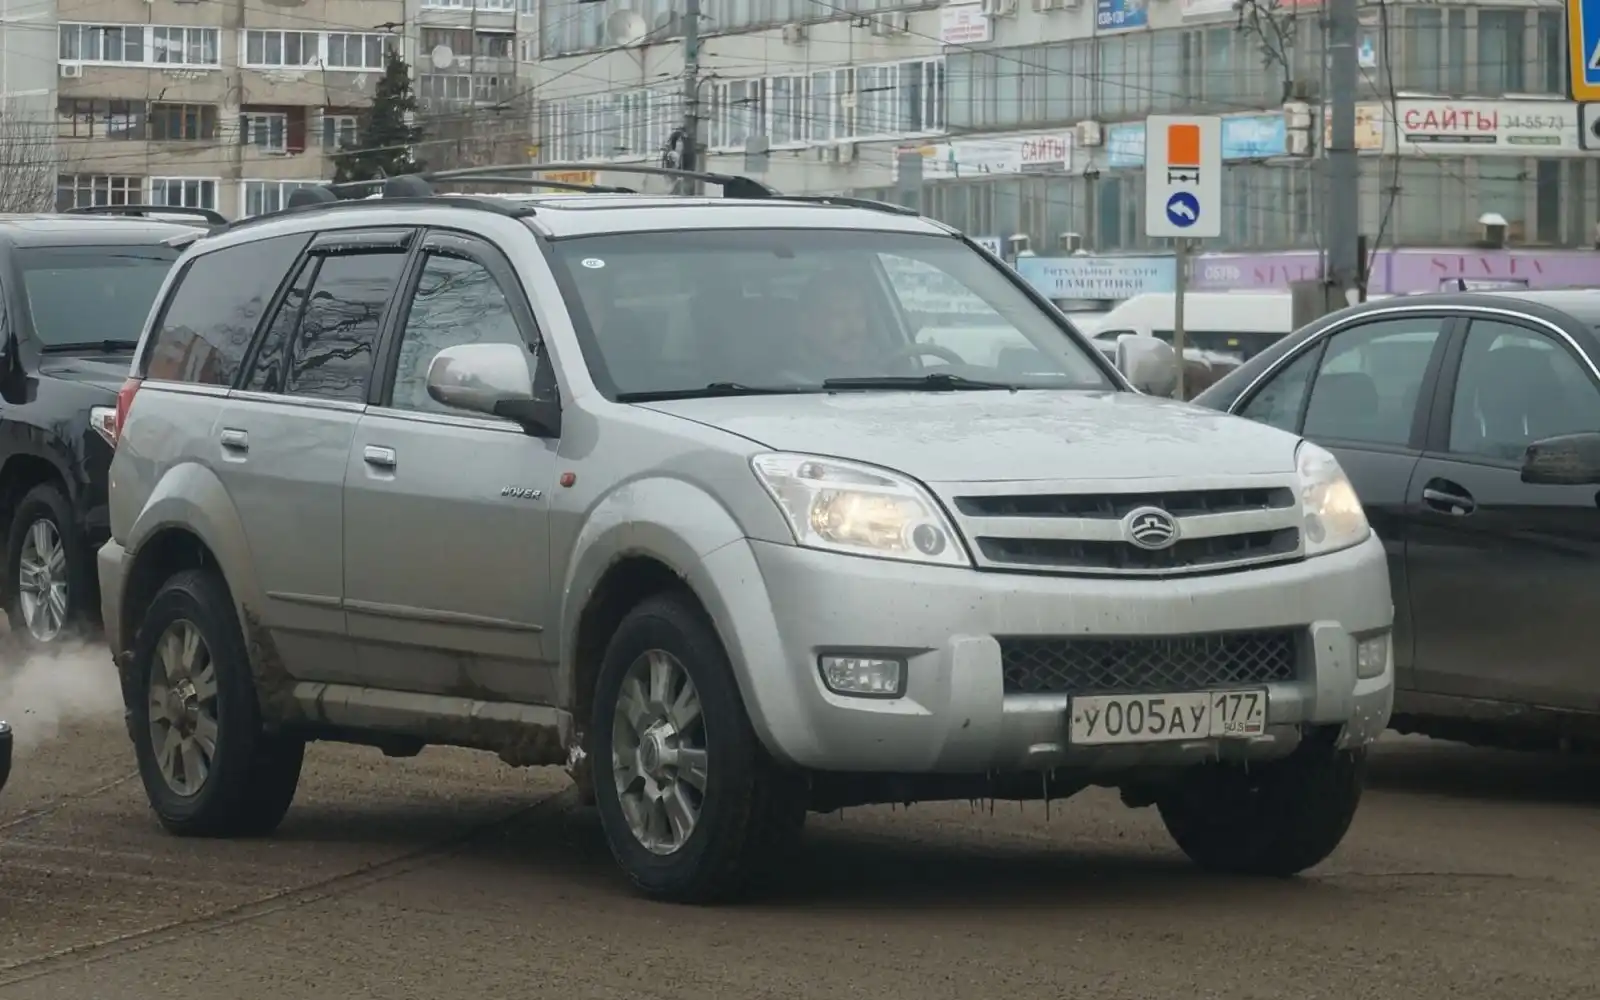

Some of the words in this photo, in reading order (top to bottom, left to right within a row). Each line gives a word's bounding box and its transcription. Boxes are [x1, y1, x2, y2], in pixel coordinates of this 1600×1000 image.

[1405, 106, 1498, 131] САЙТЫ
[1504, 114, 1564, 131] 34-55-73
[1021, 137, 1066, 161] САЙТЫ
[1055, 278, 1144, 289] ПАМЯТНИКИ
[501, 485, 542, 501] HOVER
[1083, 699, 1206, 737] У005АУ
[1214, 693, 1259, 722] 177
